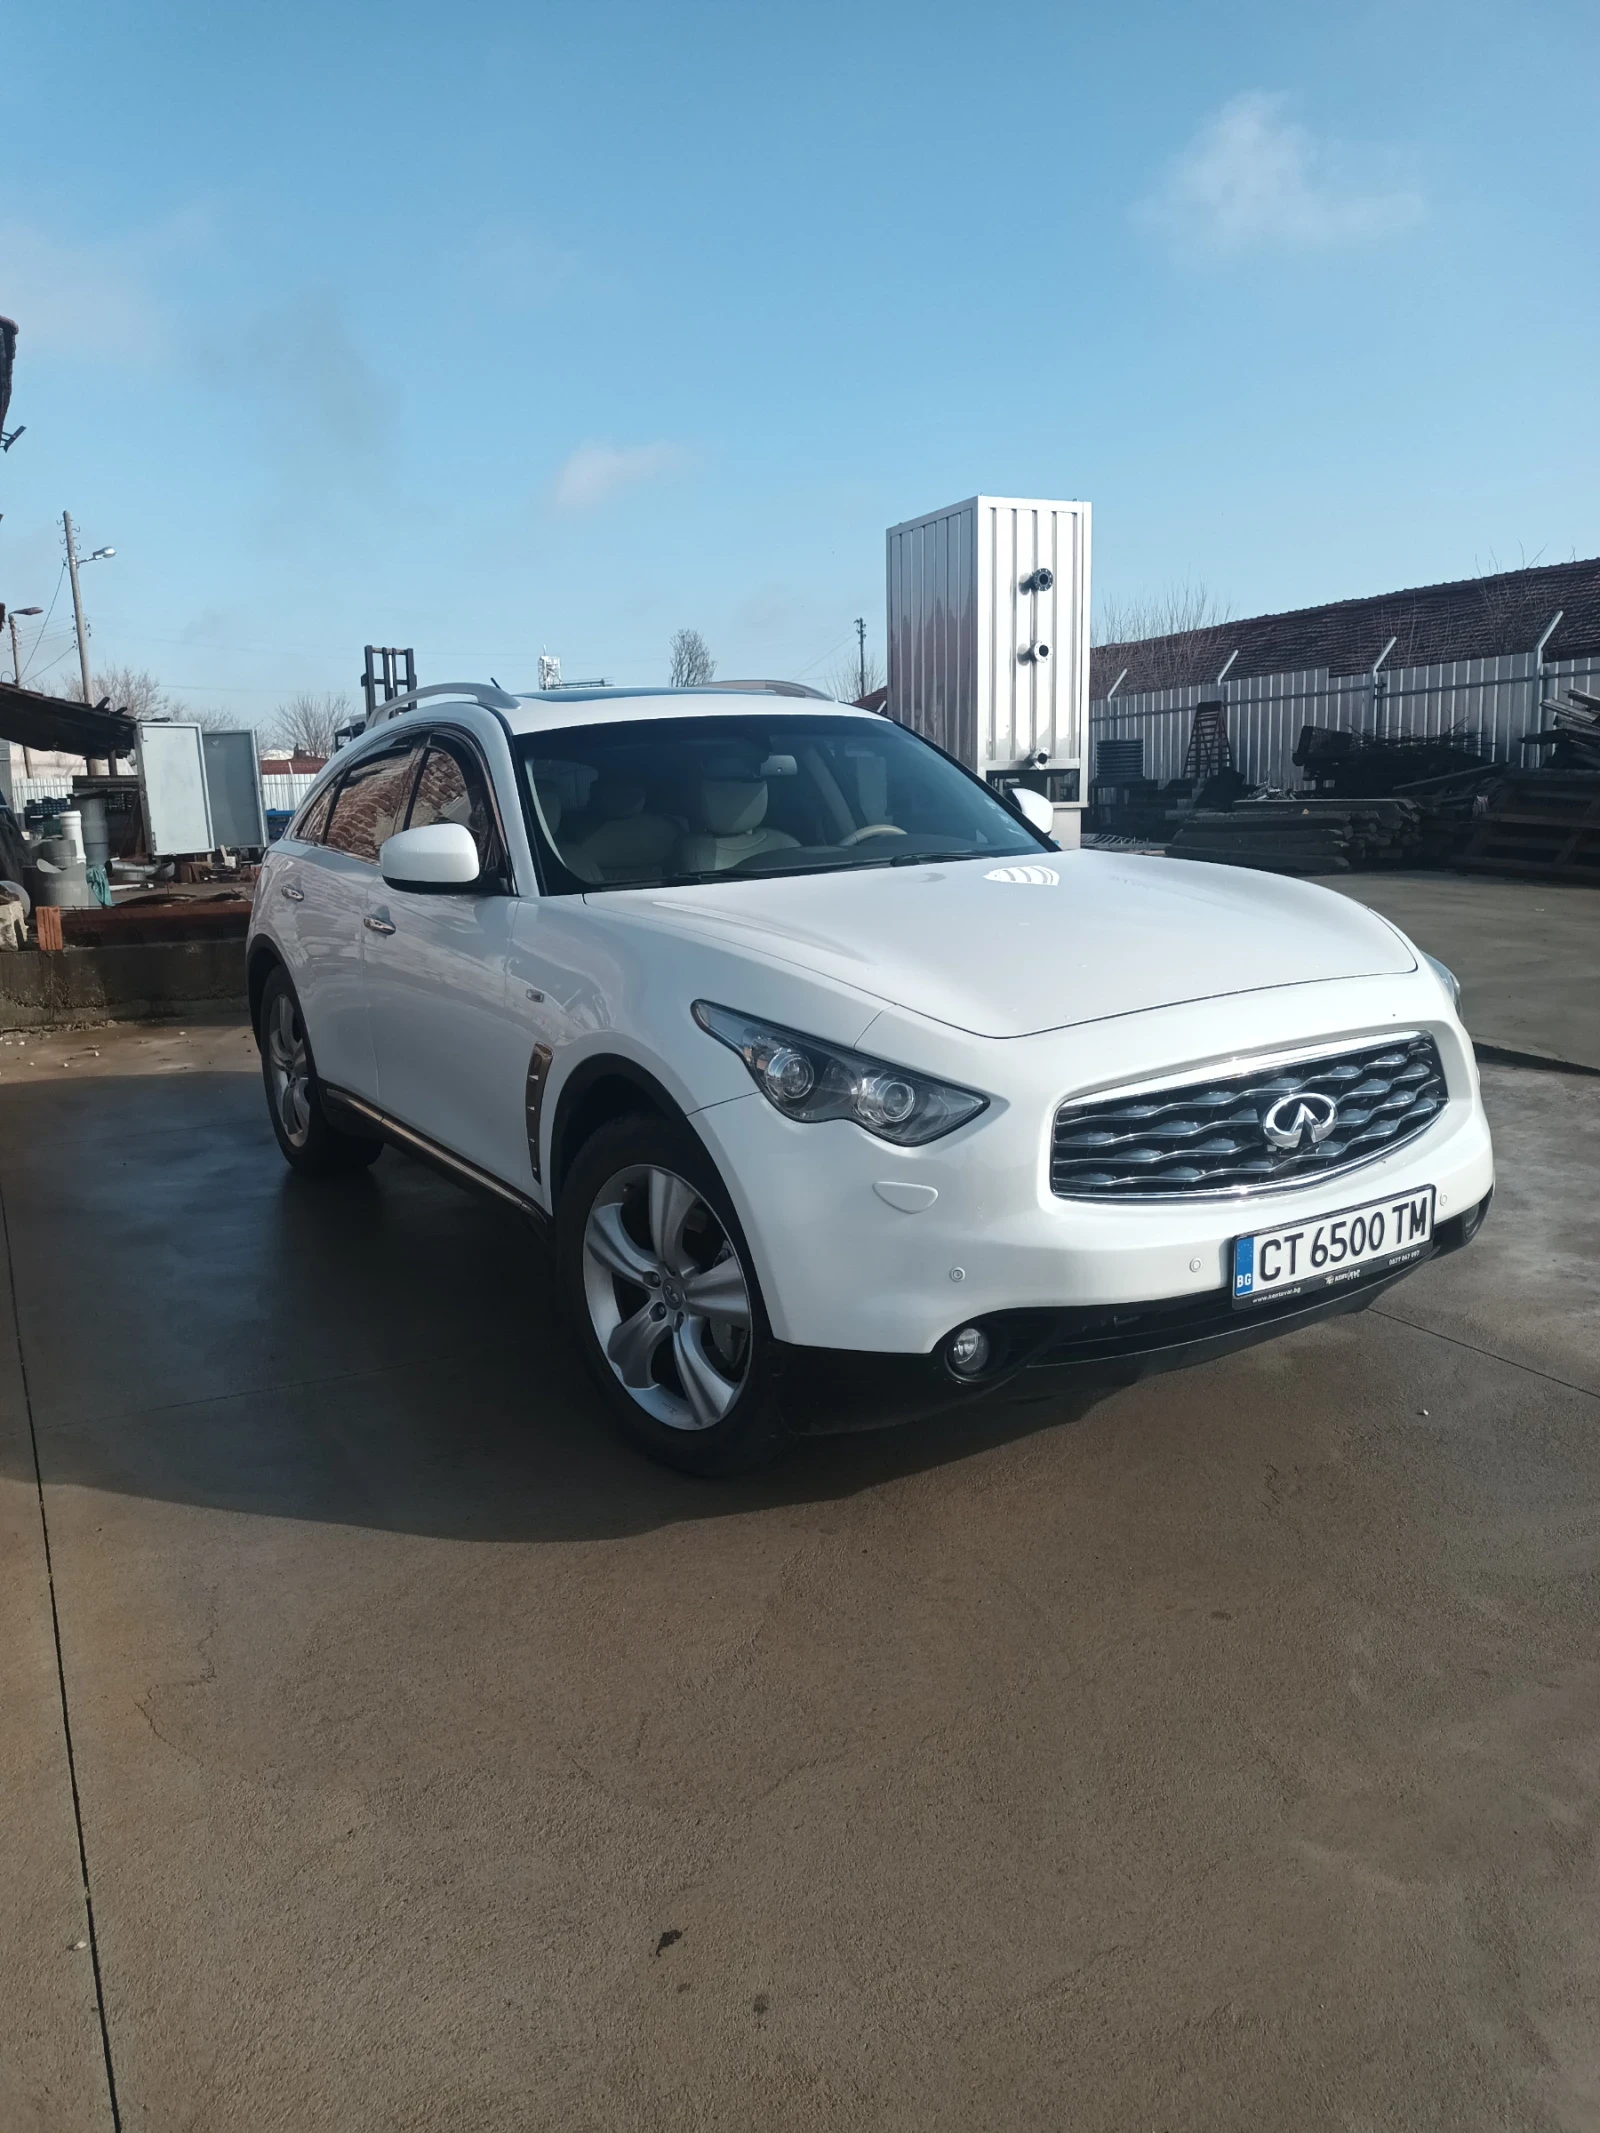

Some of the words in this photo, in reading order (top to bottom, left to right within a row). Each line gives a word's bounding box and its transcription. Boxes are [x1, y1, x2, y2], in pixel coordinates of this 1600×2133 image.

[1260, 1232, 1304, 1282] CT
[1310, 1211, 1385, 1268] 6500
[1392, 1197, 1428, 1245] TM
[1236, 1273, 1252, 1288] BG
